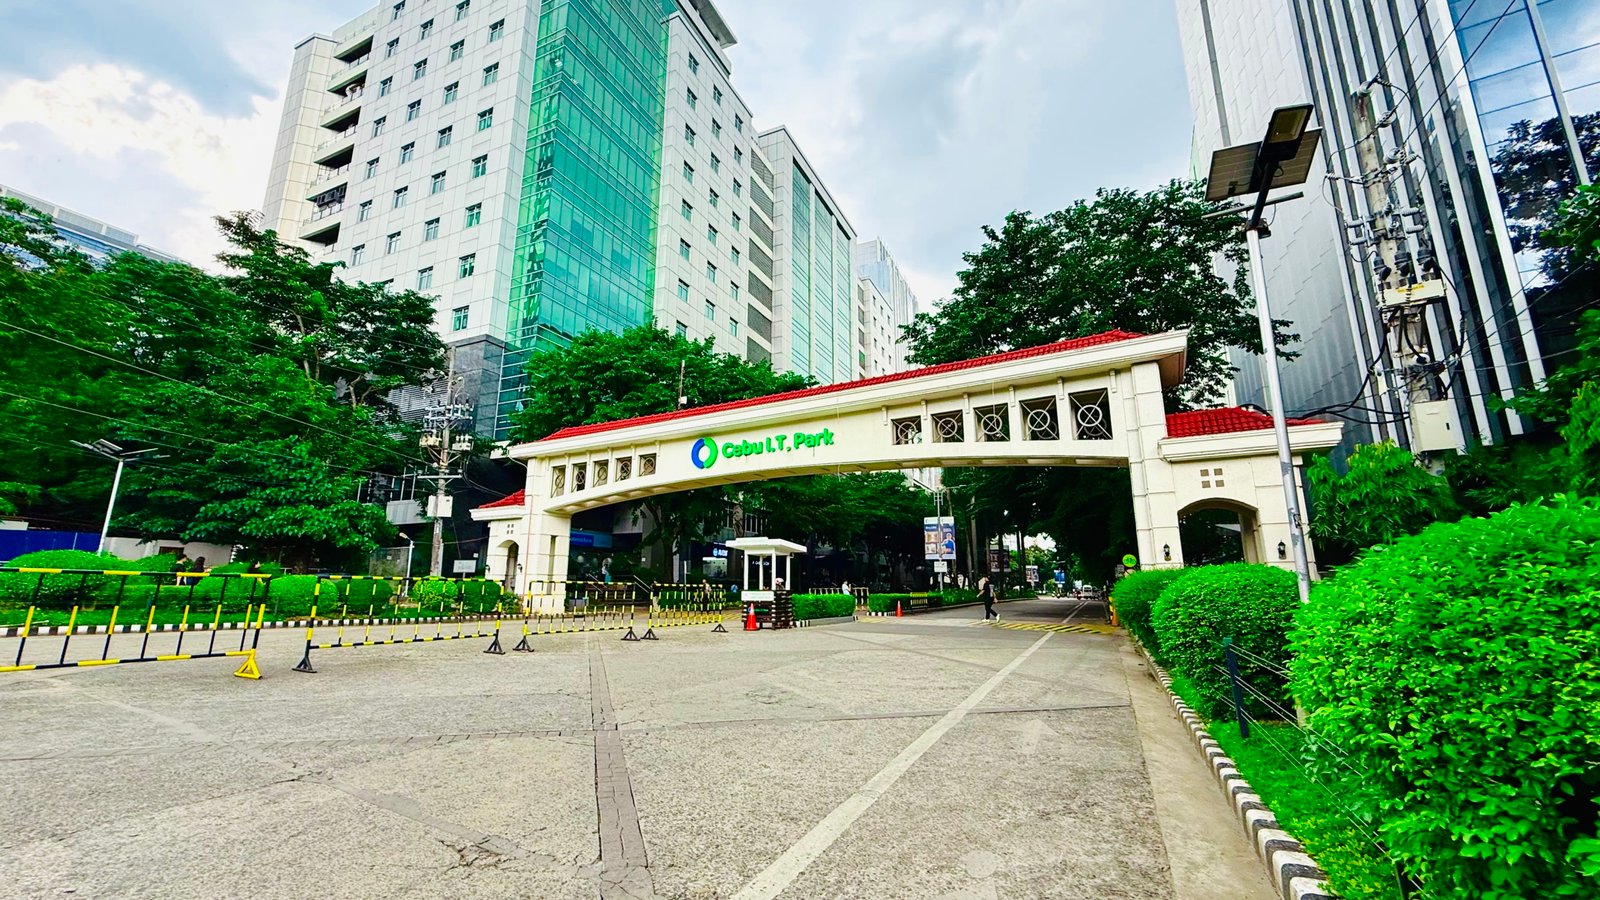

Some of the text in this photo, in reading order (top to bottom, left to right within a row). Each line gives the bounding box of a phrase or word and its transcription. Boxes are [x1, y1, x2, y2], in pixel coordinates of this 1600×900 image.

[722, 428, 834, 458] Cebu I.T. Park
